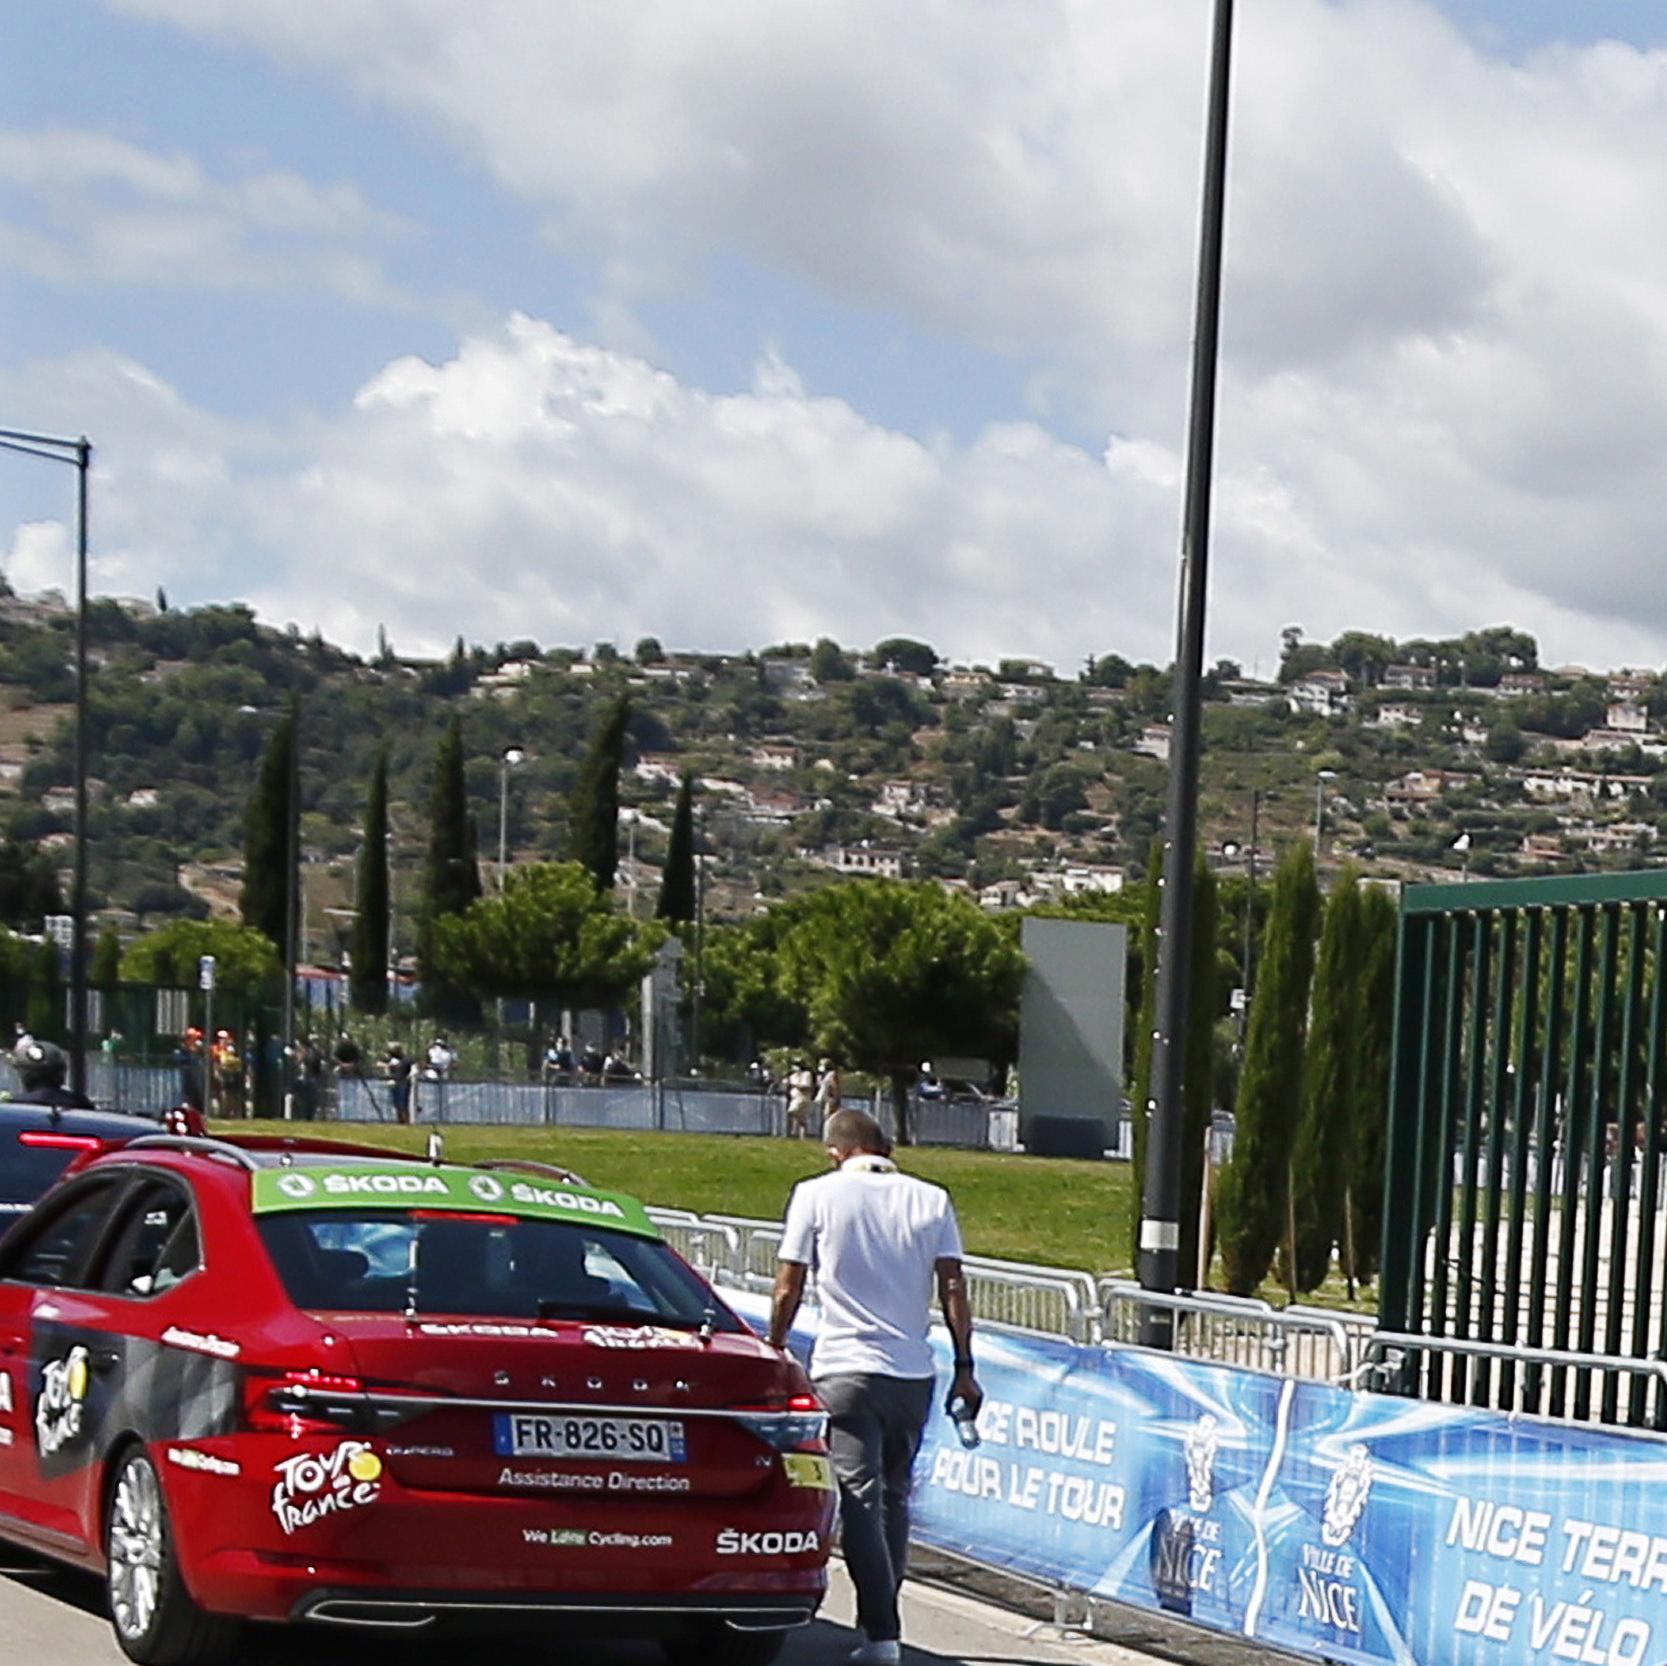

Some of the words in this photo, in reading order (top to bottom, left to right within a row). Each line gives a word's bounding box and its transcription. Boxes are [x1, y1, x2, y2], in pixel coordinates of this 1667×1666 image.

[324, 1175, 449, 1194] ŠKODA
[511, 1183, 625, 1218] ŠKODA
[516, 1418, 663, 1452] FR-826-SQ
[975, 1401, 1013, 1444] CE
[1016, 1406, 1116, 1465] ROULE
[499, 1467, 601, 1488] Assistance
[608, 1472, 690, 1491] Direction
[929, 1447, 1001, 1501] POUR
[1008, 1464, 1044, 1510] LE
[1048, 1472, 1126, 1531] TOUR
[522, 1529, 548, 1543] We
[716, 1528, 819, 1554] ŠKODA
[1446, 1497, 1551, 1566] NICE
[1154, 1535, 1223, 1593] NICE
[1297, 1567, 1361, 1633] NICE
[1454, 1580, 1521, 1641] DE
